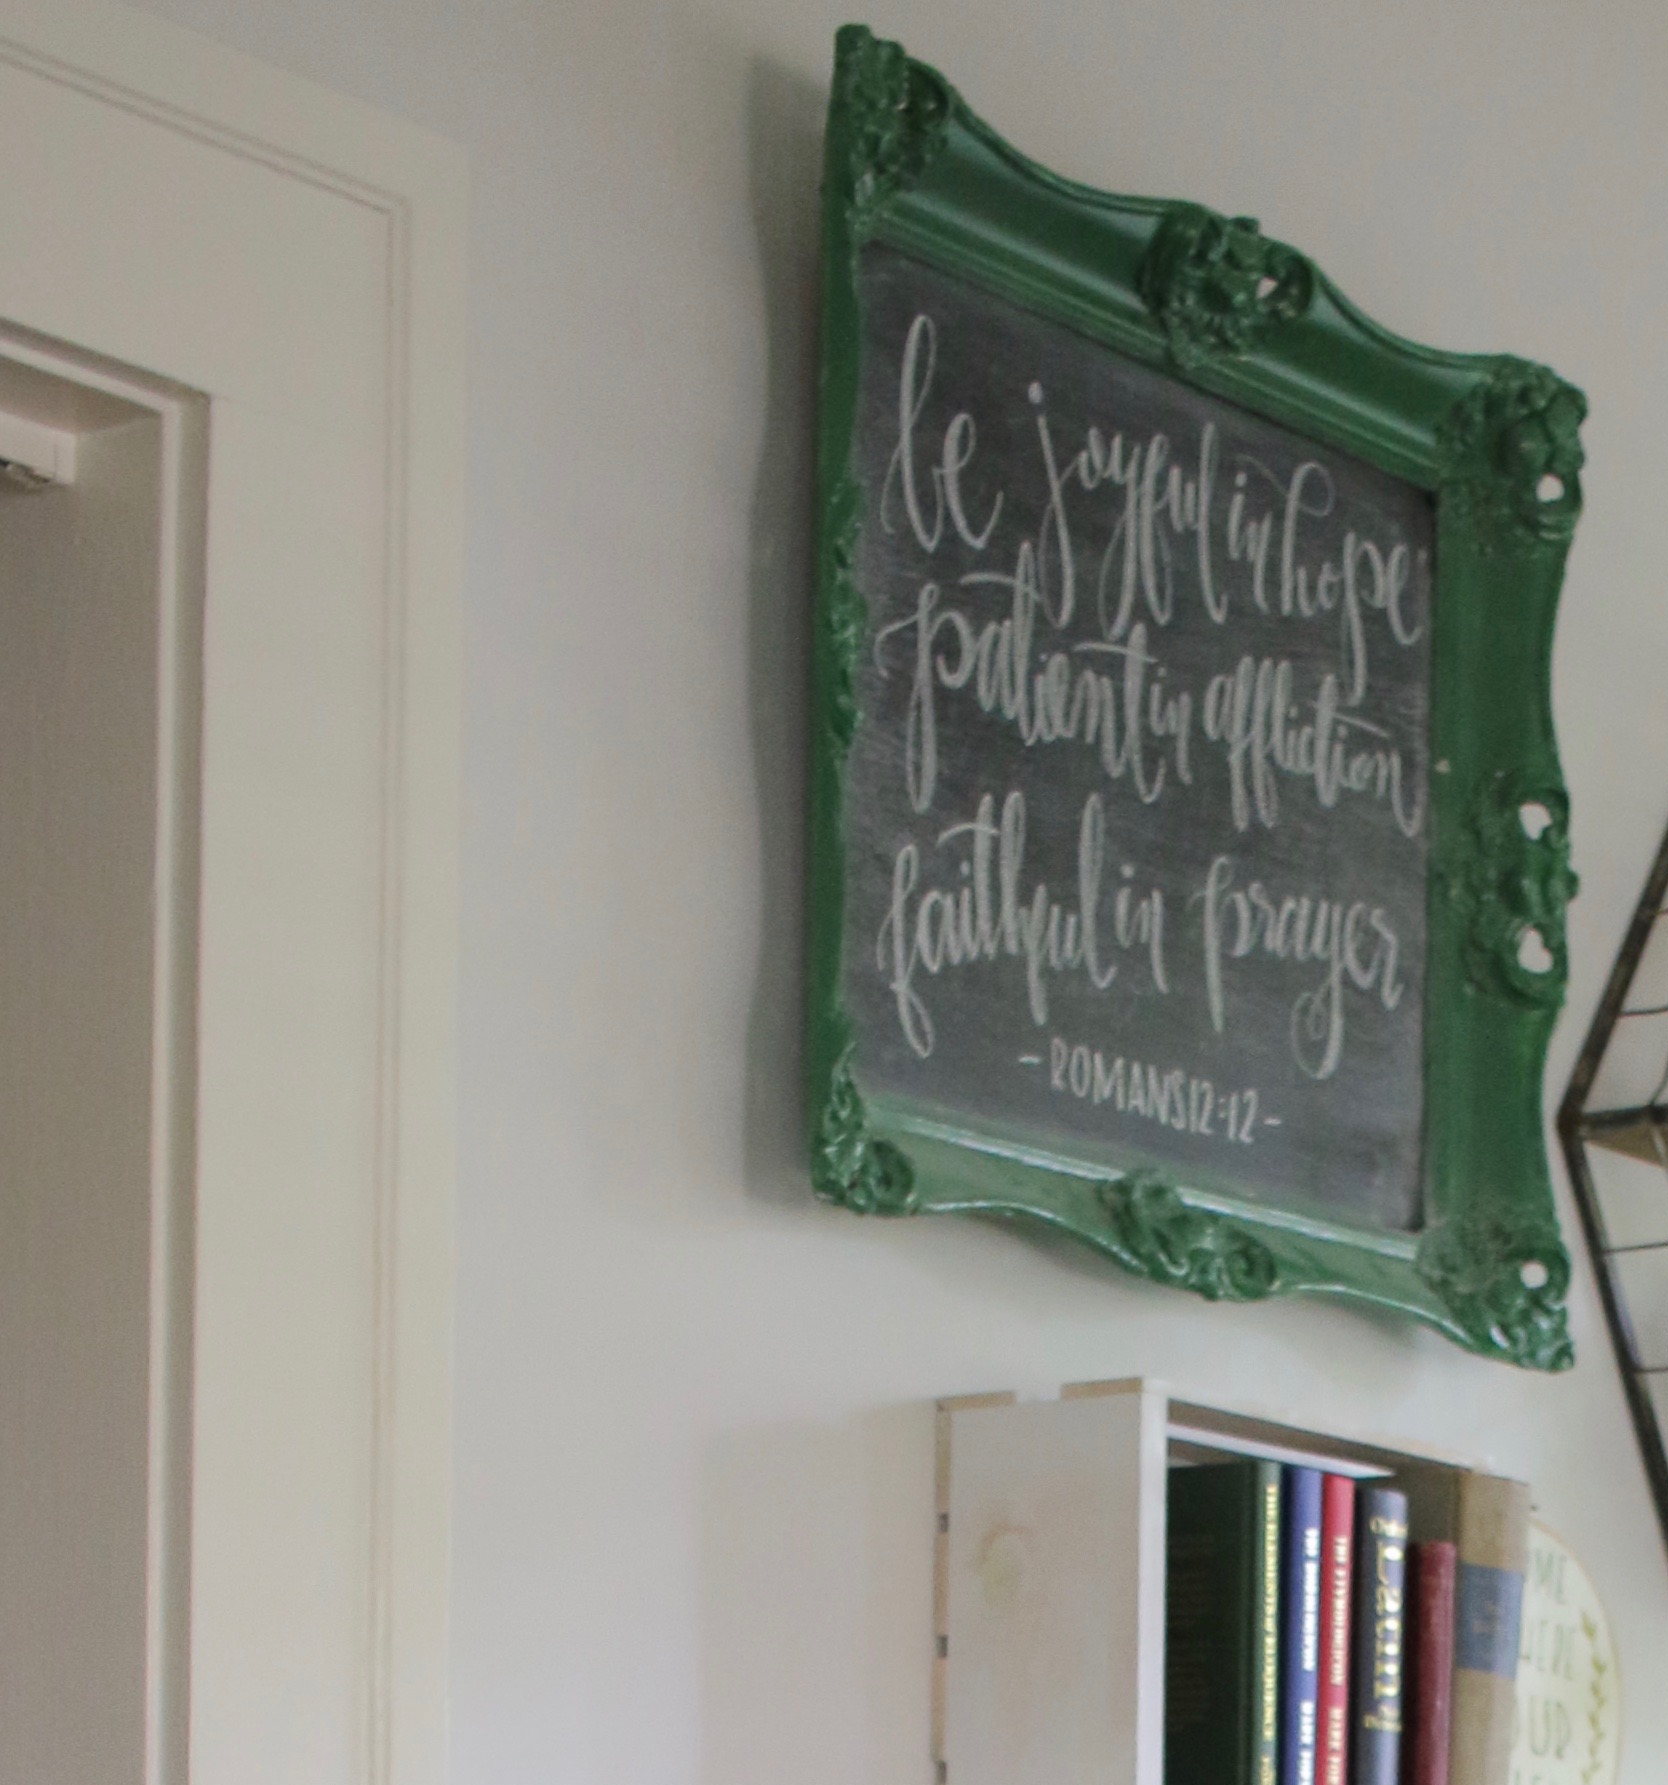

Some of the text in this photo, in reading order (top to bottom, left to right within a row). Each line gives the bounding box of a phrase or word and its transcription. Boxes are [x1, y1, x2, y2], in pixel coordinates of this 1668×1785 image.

[880, 315, 1424, 706] be joyful in hope
[876, 541, 1428, 837] patient in affliction
[876, 790, 1405, 1081] faithful in prayer
